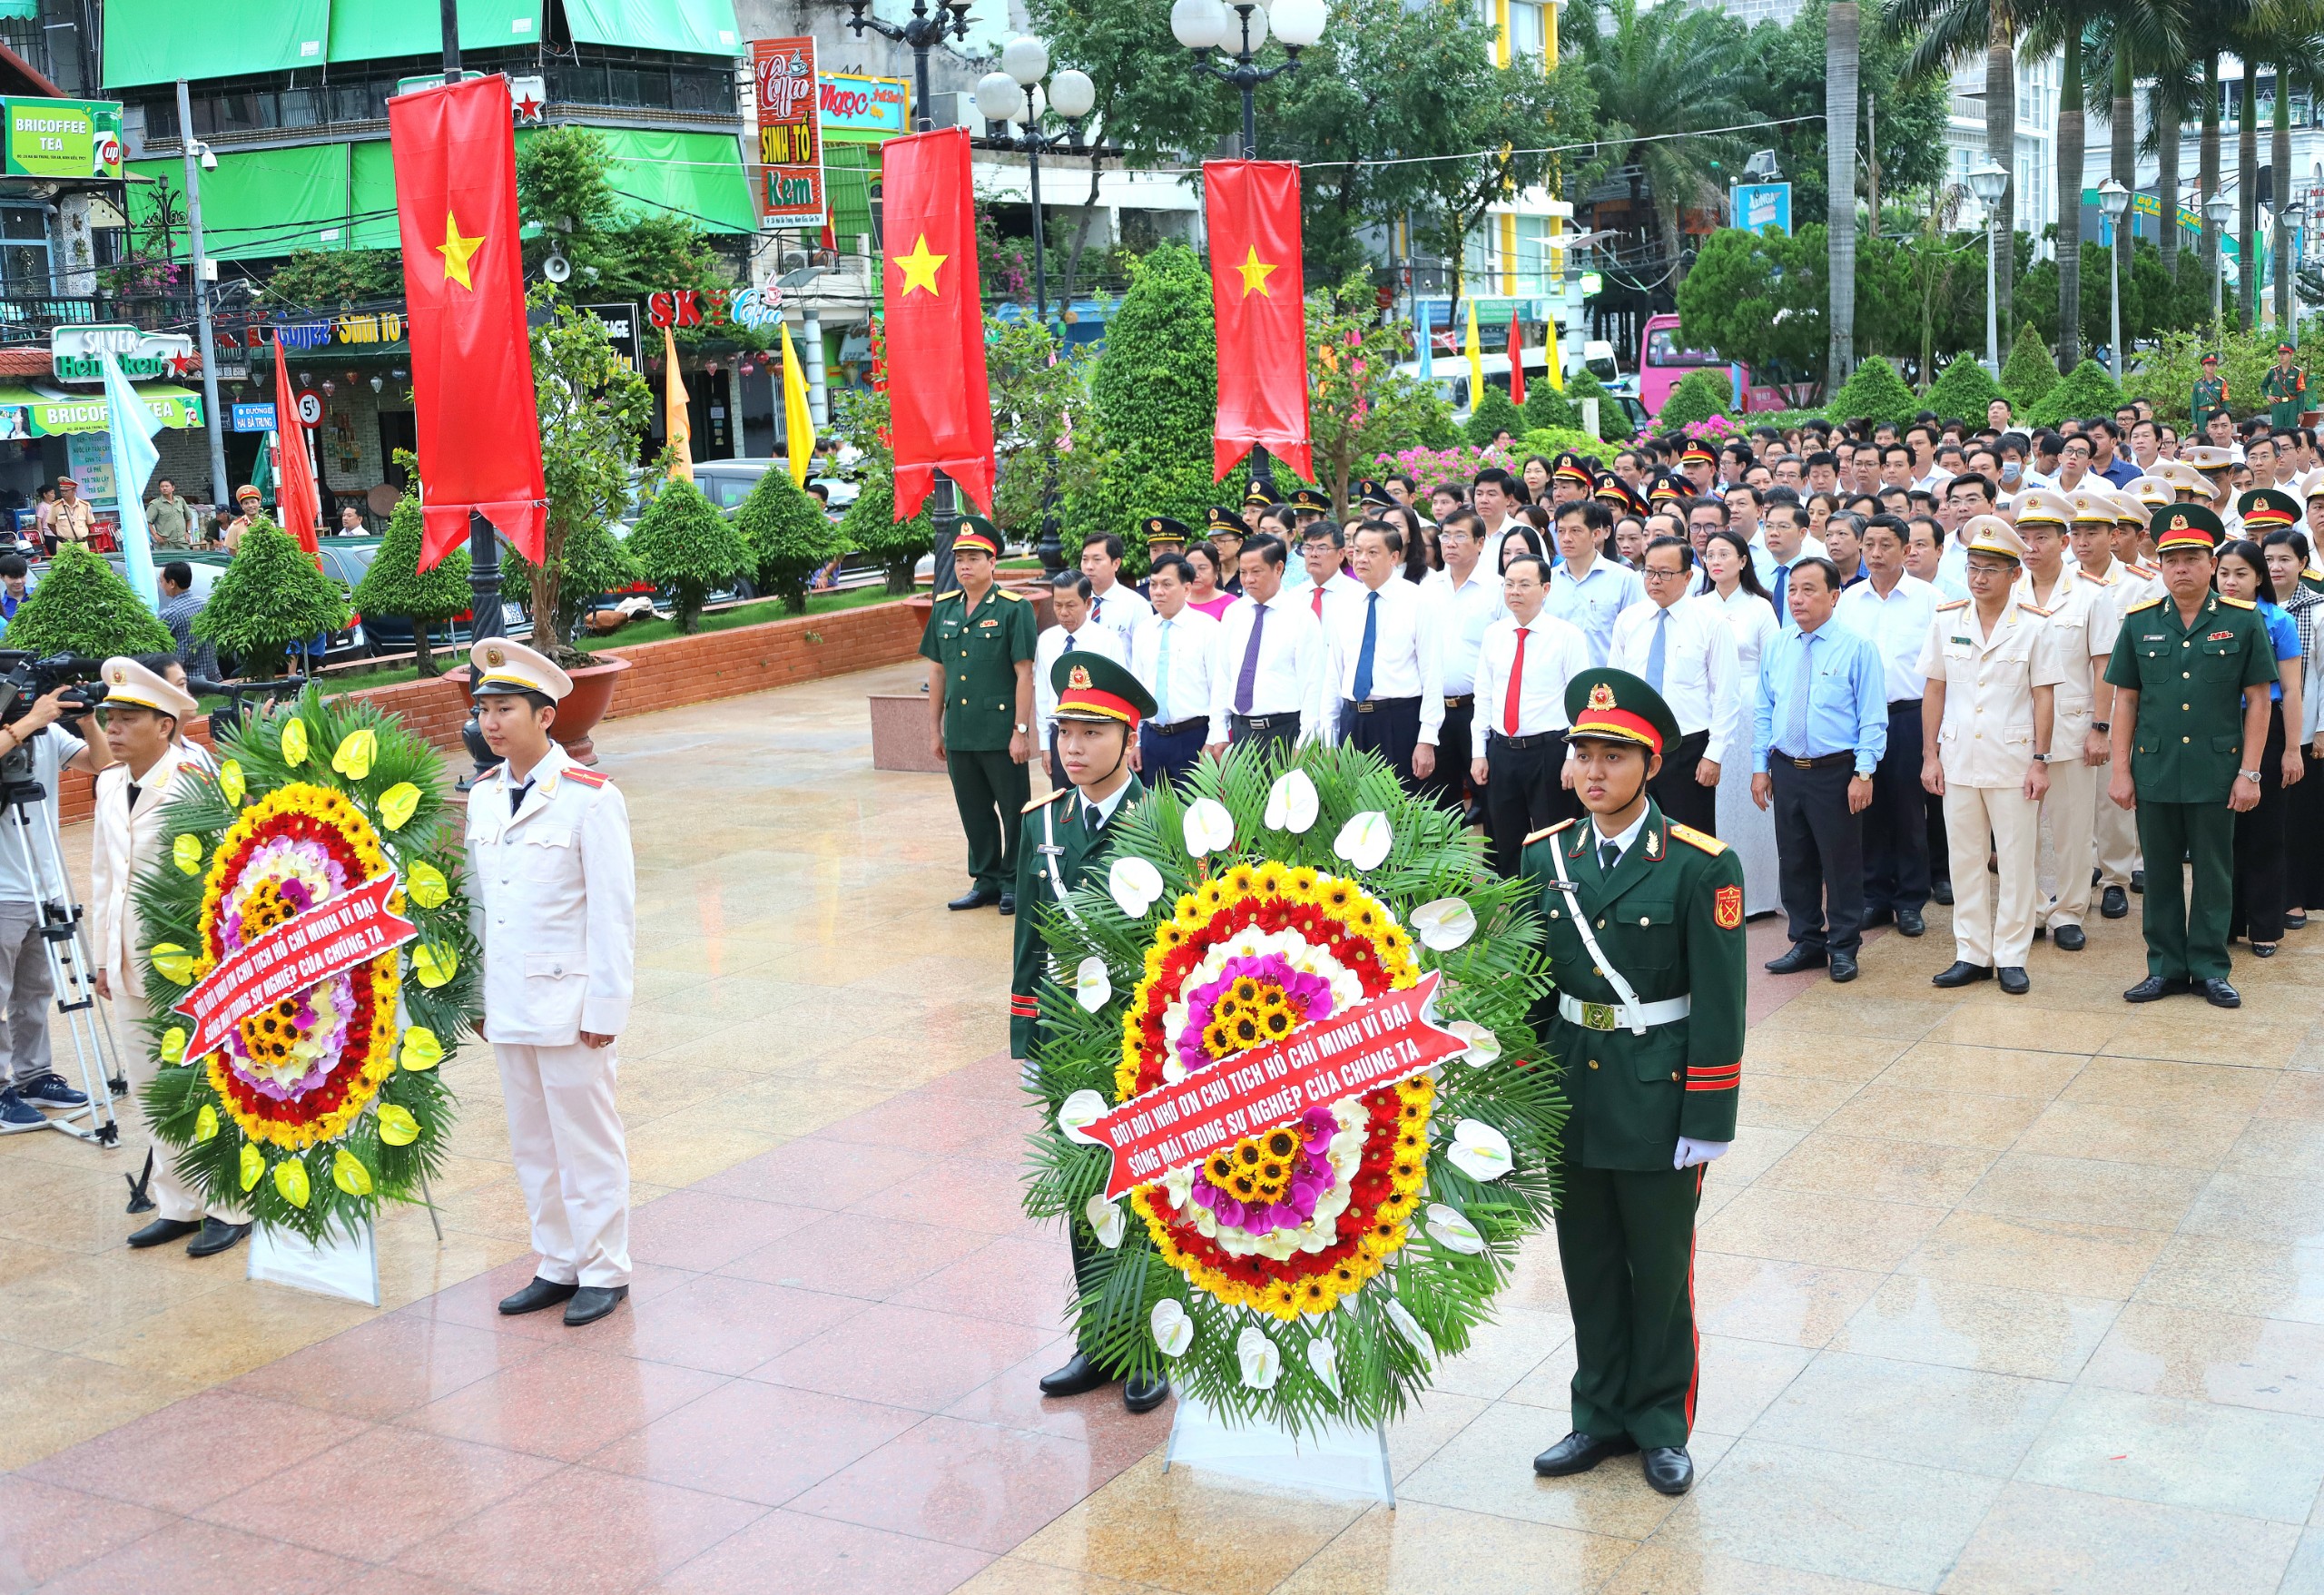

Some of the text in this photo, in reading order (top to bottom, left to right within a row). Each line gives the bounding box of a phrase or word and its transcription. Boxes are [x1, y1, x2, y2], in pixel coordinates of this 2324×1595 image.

[758, 54, 809, 118] Coffee
[15, 118, 86, 134] BRICOFFEE
[39, 137, 64, 152] TEA
[762, 110, 812, 163] SINH TỐ
[767, 171, 812, 206] Kem
[730, 288, 784, 333] Coffee
[84, 330, 137, 354] SILVER
[236, 418, 246, 428] HAI
[247, 416, 255, 428] BÀ
[246, 406, 268, 415] ĐƯỜNG
[213, 974, 230, 1002] NHỚ
[226, 970, 238, 991] ƠN
[235, 955, 254, 984] CHỦ
[251, 947, 274, 974] TỊCH
[271, 932, 289, 961] HỒ
[287, 924, 309, 952] CHÍ
[305, 912, 342, 943] MINH
[338, 901, 355, 927] VĨ
[352, 896, 378, 921] ĐẠI
[204, 925, 385, 1044] SỐNG MÃI TRONG SỰ NGHIỆP CỦA CHÚNG TA
[1109, 1000, 1413, 1147] ĐỜI ĐỜI NHỚ ƠN CHỦ TỊCH HỒ CHÍ MINH VĨ ĐẠI
[1128, 1038, 1422, 1177] SỐNG MÃI TRONG SỰ NGHIỆP CỦA CHÚNG TA
